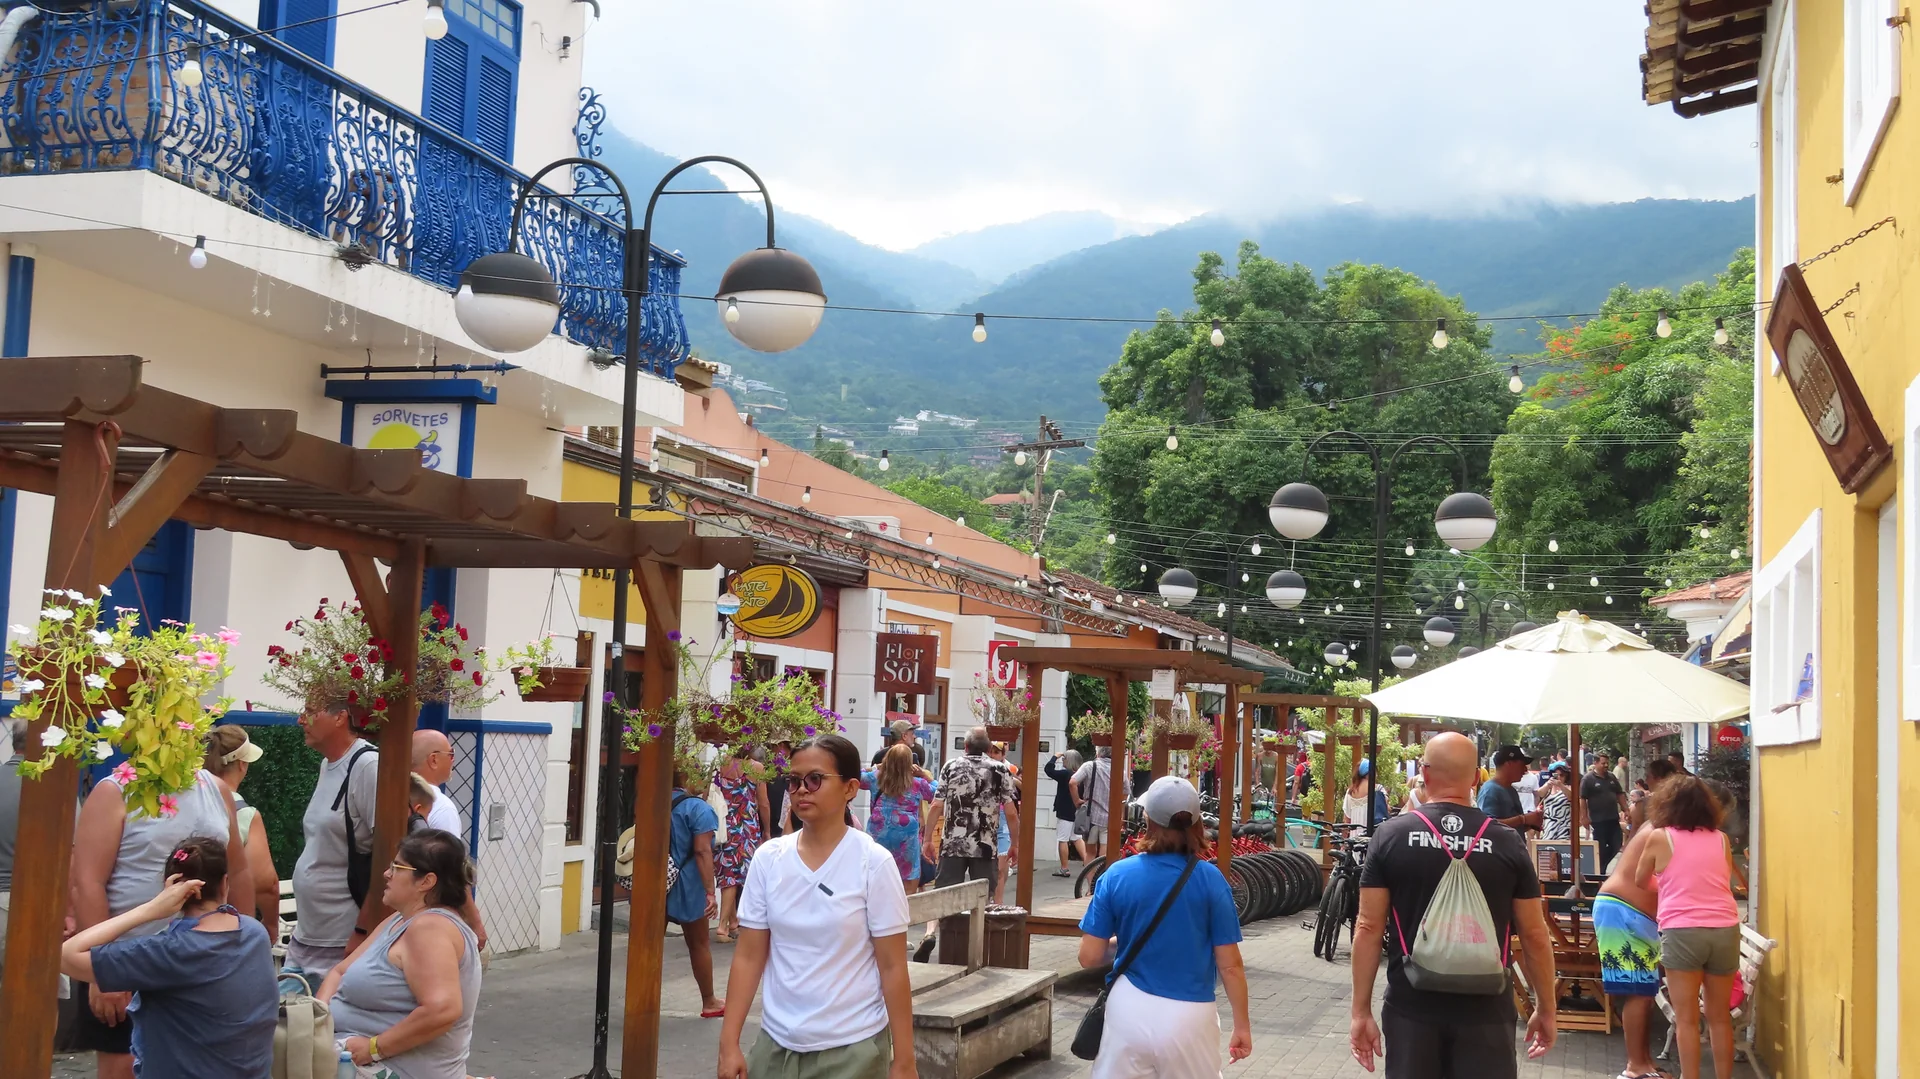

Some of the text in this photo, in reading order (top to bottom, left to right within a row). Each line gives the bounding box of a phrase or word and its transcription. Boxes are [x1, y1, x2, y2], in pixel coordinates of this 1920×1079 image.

[372, 408, 449, 427] SORVETES
[885, 643, 924, 660] Flor
[882, 660, 919, 684] Sol
[1408, 831, 1493, 854] FINISHER
